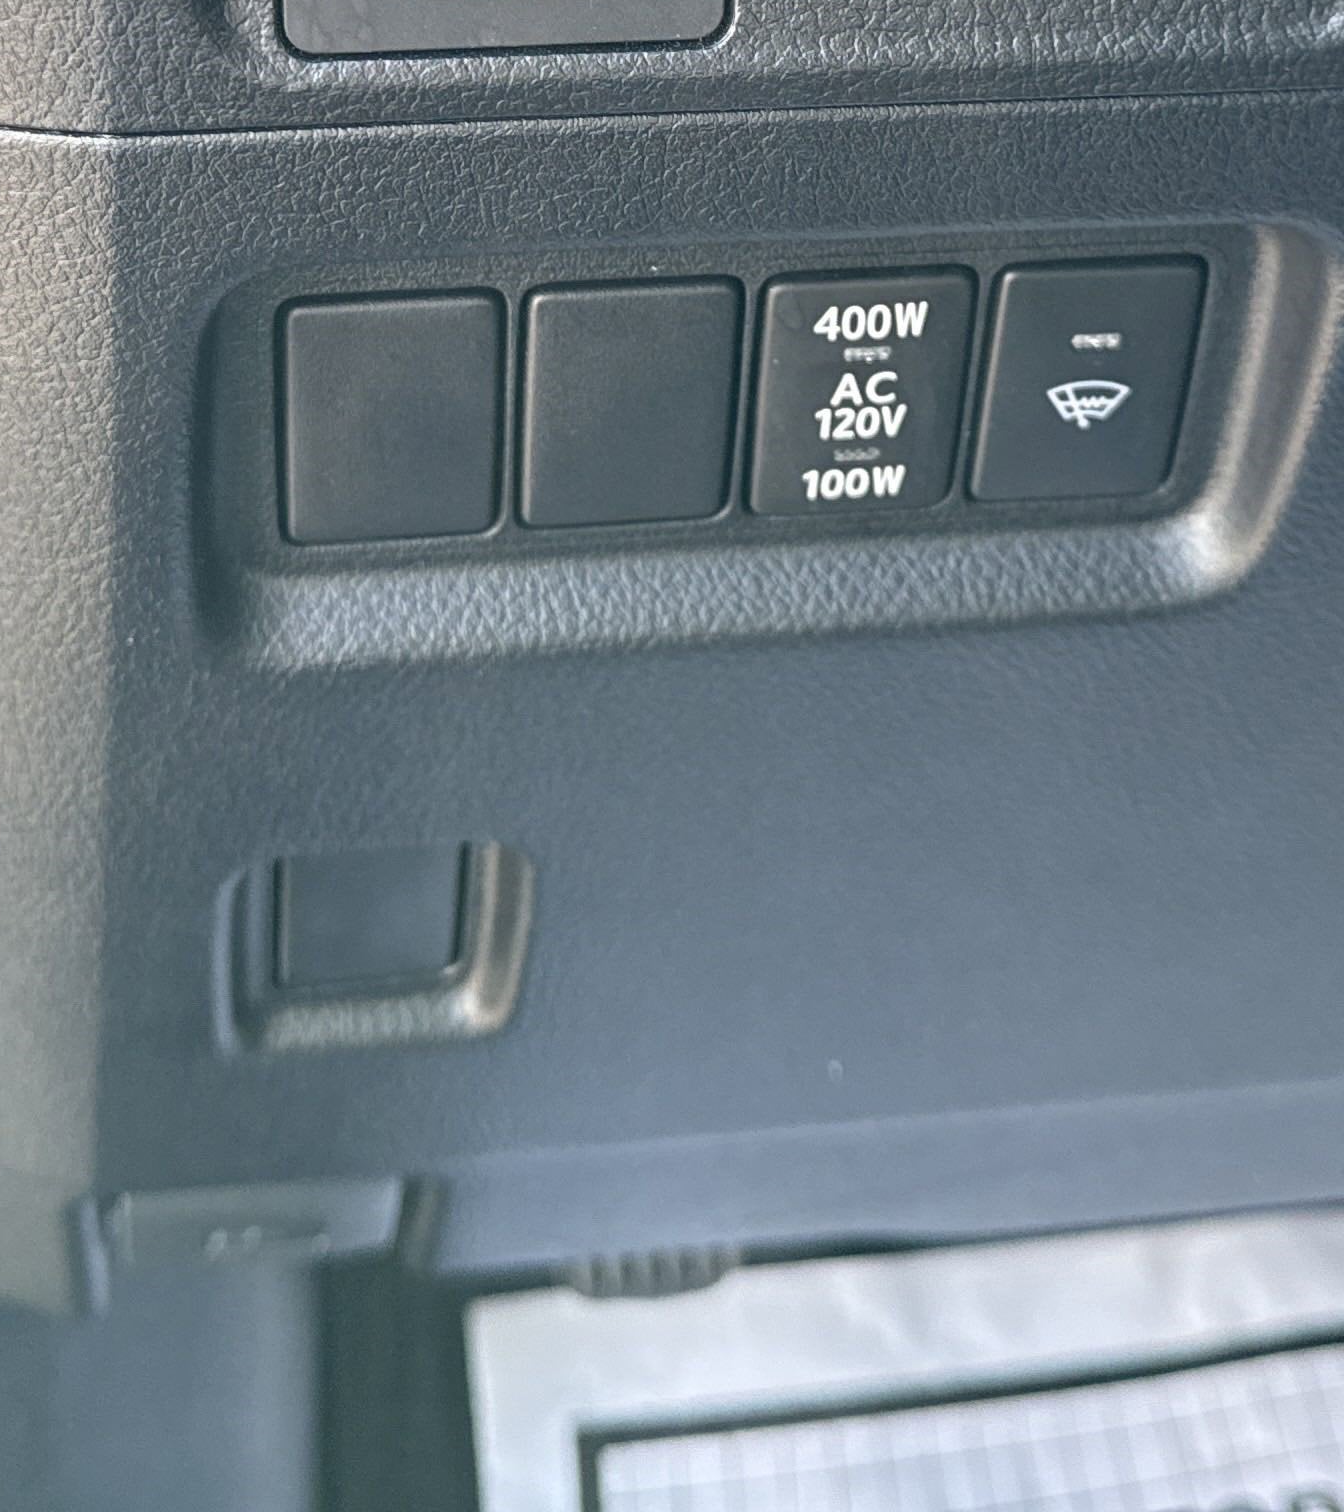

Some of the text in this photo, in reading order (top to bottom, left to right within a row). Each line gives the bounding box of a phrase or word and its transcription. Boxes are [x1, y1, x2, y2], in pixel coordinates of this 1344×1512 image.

[813, 300, 929, 342] 400W
[830, 370, 899, 406] AC
[814, 403, 908, 441] 120V
[801, 464, 906, 501] 100W
